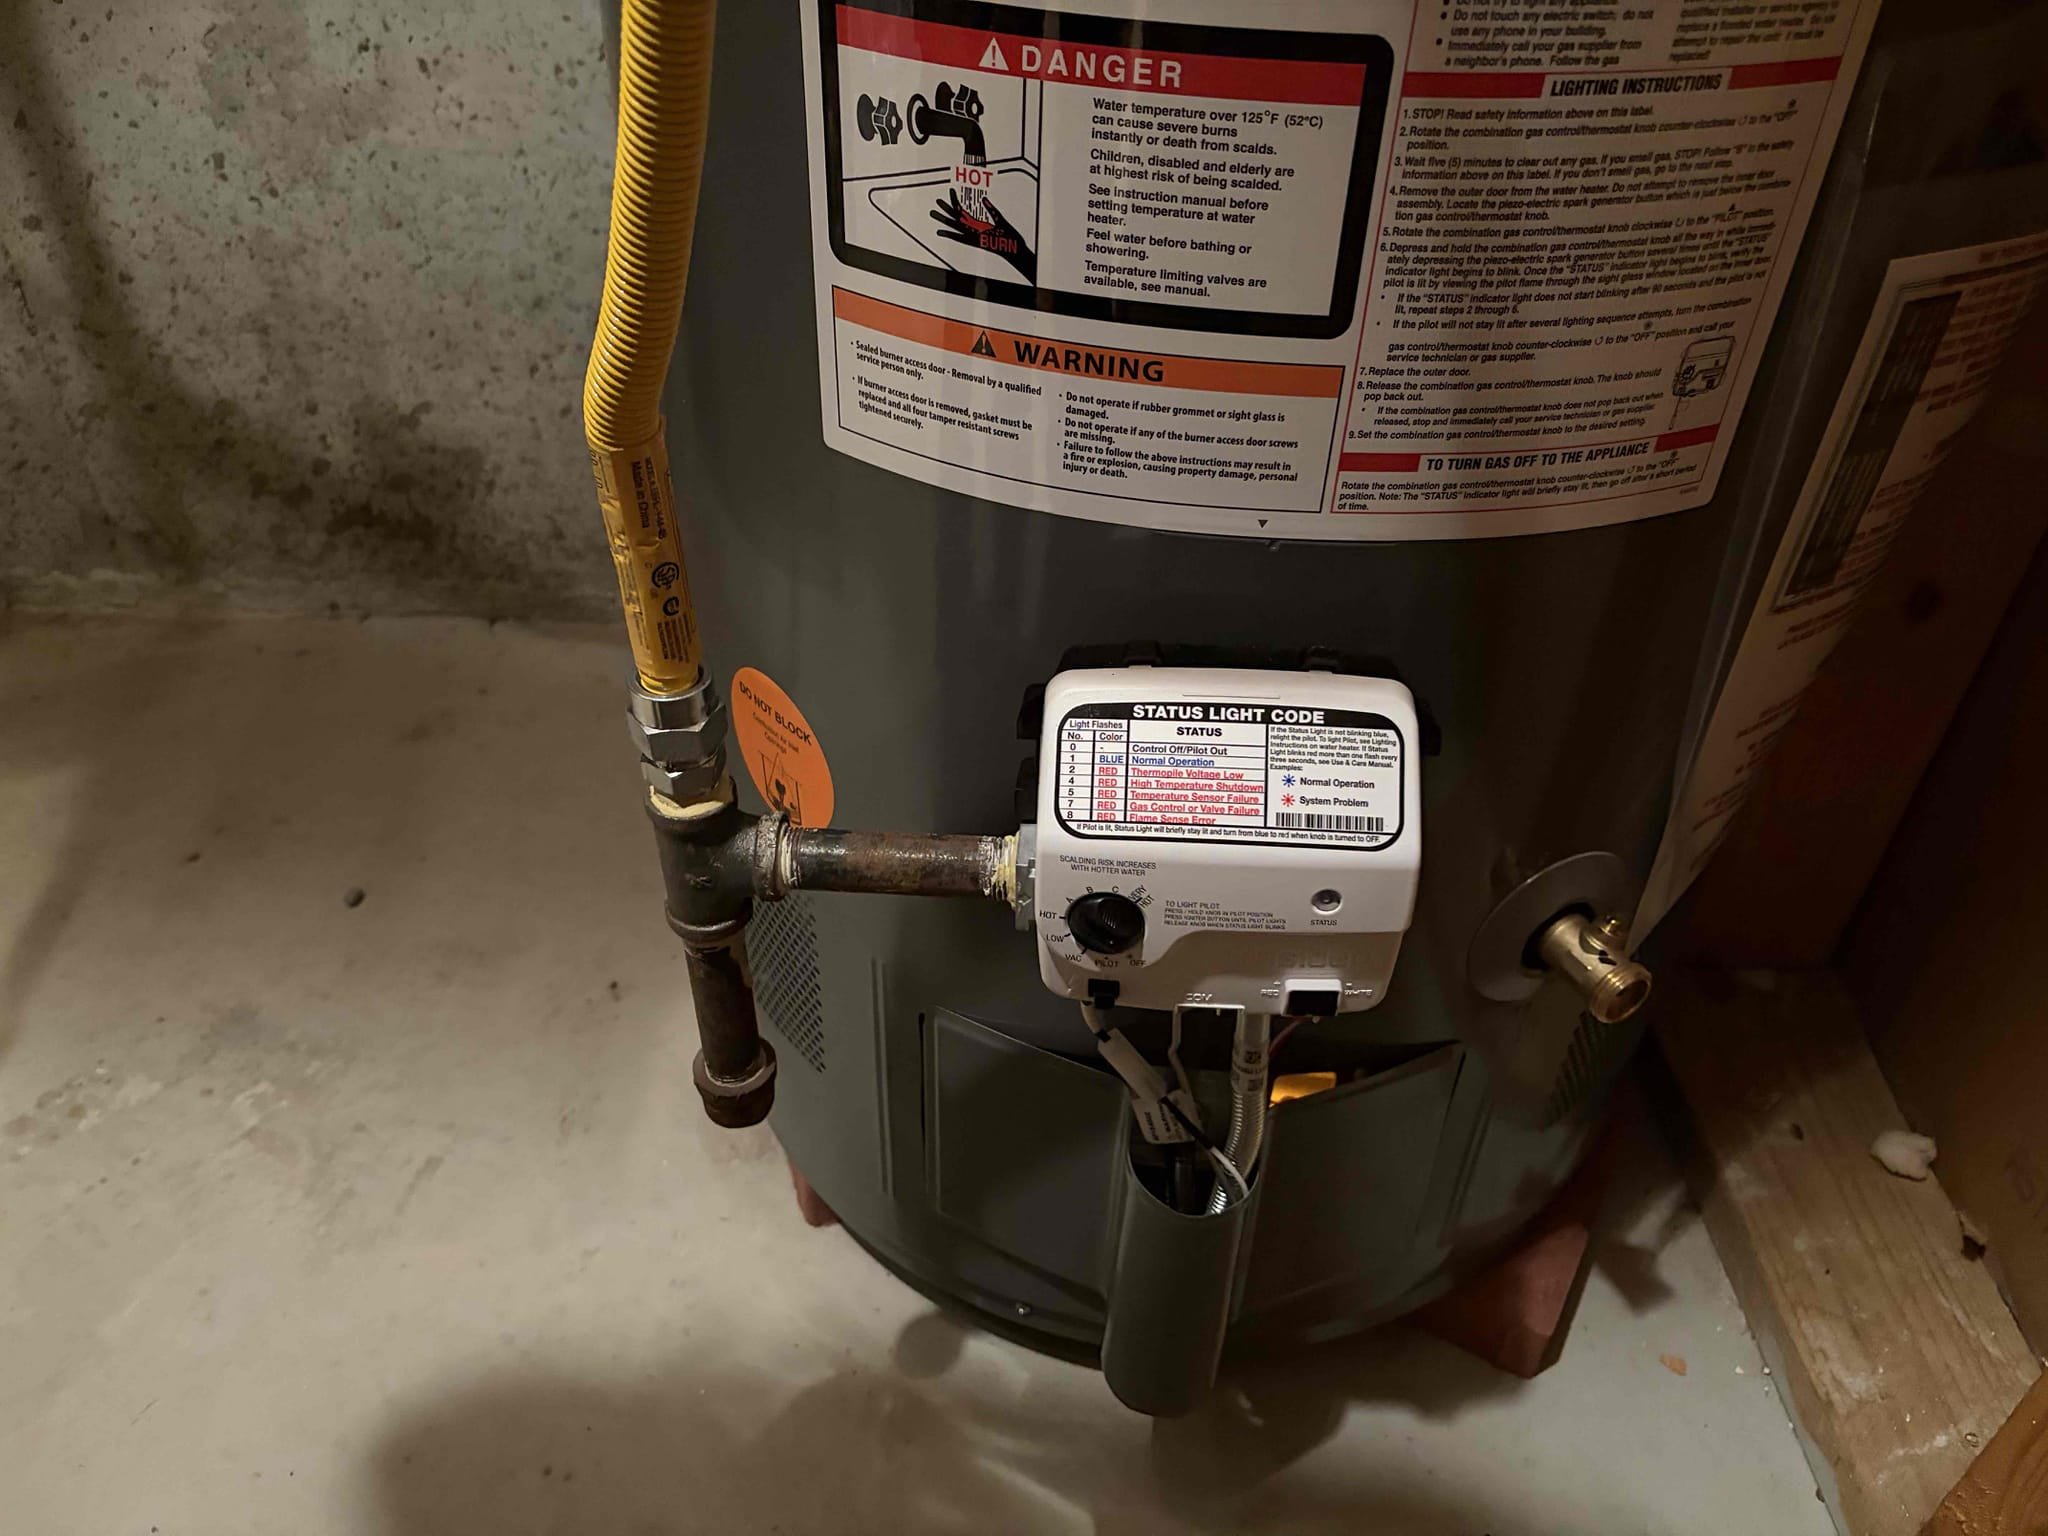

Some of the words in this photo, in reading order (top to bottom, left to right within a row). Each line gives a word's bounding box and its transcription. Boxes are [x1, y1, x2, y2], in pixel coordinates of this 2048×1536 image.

[1021, 46, 1181, 88] DANGER
[1549, 79, 1619, 97] LIGHTING
[1621, 74, 1723, 94] INSTRUCTIONS
[1093, 97, 1128, 112] Water
[1131, 103, 1207, 120] temperature
[1209, 111, 1238, 123] over
[1091, 115, 1114, 126] can
[1116, 118, 1154, 130] cause
[1156, 122, 1198, 135] severe
[1201, 124, 1238, 138] burns
[1091, 128, 1144, 147] instantly
[1146, 136, 1160, 146] or
[1162, 137, 1197, 149] death
[1200, 139, 1230, 152] from
[1232, 143, 1277, 155] scalds.
[1090, 148, 1145, 167] Children,
[1147, 155, 1200, 171] disabled
[1202, 162, 1227, 173] and
[1229, 163, 1272, 179] elderly
[1274, 167, 1295, 178] are
[955, 166, 993, 188] HOT
[1089, 164, 1101, 175] at
[1103, 165, 1149, 180] highest
[1151, 170, 1175, 183] risk
[1177, 173, 1191, 185] of
[1193, 174, 1228, 190] being
[1230, 179, 1282, 191] scalded.
[1088, 183, 1111, 197] See
[1113, 187, 1178, 204] instruction
[1181, 196, 1227, 208] manual
[1229, 198, 1269, 211] before
[1087, 199, 1128, 215] setting
[1131, 204, 1204, 220] temperature
[1206, 211, 1219, 222] at
[1221, 213, 1256, 224] water
[1087, 212, 1127, 227] heater.
[979, 234, 1017, 254] BURN
[1086, 227, 1111, 241] Feel
[1113, 233, 1147, 245] water
[1149, 235, 1188, 249] before
[1190, 239, 1236, 256] bathing
[1238, 245, 1253, 255] or
[1085, 243, 1149, 261] showering.
[1084, 260, 1157, 279] Temperature
[1159, 269, 1204, 286] limiting
[1206, 274, 1245, 287] valves
[1247, 278, 1267, 289] are
[1083, 276, 1138, 291] available,
[1140, 282, 1162, 293] see
[1164, 285, 1211, 297] manual.
[856, 353, 880, 366] service
[881, 360, 905, 374] person
[905, 368, 924, 381] only.
[1013, 340, 1164, 382] WARNING
[855, 340, 879, 355] Sealed
[879, 348, 904, 363] burner
[904, 357, 928, 370] access
[927, 362, 946, 375] door
[951, 368, 986, 384] Removal
[986, 376, 997, 389] by
[997, 381, 1004, 389] a
[1004, 382, 1042, 396] qualified
[1368, 367, 1405, 378] Replace
[1406, 367, 1422, 377] the
[1423, 368, 1447, 377] outer
[1448, 368, 1471, 377] door.
[1427, 458, 1444, 471] TO
[1447, 458, 1482, 470] TURN
[1484, 456, 1511, 469] GAS
[1513, 455, 1538, 468] OFF
[1541, 453, 1558, 466] TO
[1561, 450, 1584, 464] THE
[1585, 442, 1650, 461] APPLIANCE
[739, 681, 752, 700] DO
[754, 695, 772, 716] NOT
[775, 711, 812, 746] BLOCK
[1132, 705, 1204, 719] STATUS
[1209, 707, 1265, 721] LIGHT
[1270, 709, 1325, 724] CODE
[1069, 720, 1089, 730] Light
[1092, 721, 1123, 729] Flashes
[1067, 732, 1083, 740] No.
[1099, 733, 1123, 741] Color
[1176, 727, 1223, 737] STATUS
[1069, 742, 1077, 751] 0
[1132, 744, 1167, 754] Control
[1168, 745, 1208, 756] Off/Pilot
[1209, 746, 1228, 756] Out
[1070, 754, 1075, 762] 1
[1099, 755, 1124, 763] BLUE
[1132, 756, 1165, 765] Normal
[1168, 758, 1215, 767] Operation
[1068, 766, 1076, 774] 2
[1099, 767, 1118, 775] RED
[1131, 768, 1184, 779] Thermopile
[1186, 770, 1221, 779] Voltage
[1223, 772, 1244, 780] Low
[1068, 777, 1075, 785] 4
[1098, 778, 1117, 787] RED
[1131, 780, 1152, 789] High
[1155, 780, 1213, 790] Temperature
[1216, 782, 1264, 792] Shutdown
[1299, 777, 1332, 787] Normal
[1332, 779, 1375, 789] Operation
[1067, 788, 1075, 796] 5
[1098, 790, 1117, 798] RED
[1130, 791, 1189, 801] Temperature
[1191, 793, 1225, 802] Sensor
[1227, 795, 1259, 804] Failure
[1067, 799, 1074, 808] 7
[1097, 801, 1117, 809] RED
[1299, 796, 1332, 806] System
[1333, 797, 1369, 807] Problem
[1130, 803, 1149, 812] Gas
[1151, 803, 1185, 813] Control
[1200, 805, 1226, 814] Valve
[1228, 806, 1260, 815] Failure
[1066, 811, 1074, 820] 8
[1097, 813, 1116, 821] RED
[1130, 814, 1159, 823] Flame
[1161, 815, 1189, 824] Sense
[1192, 816, 1216, 825] Error
[1059, 855, 1097, 865] SCALDING
[1097, 858, 1115, 867] RISK
[1116, 860, 1157, 870] INCREASES
[1070, 864, 1090, 872] WITH
[1090, 866, 1120, 874] HOTTER
[1120, 868, 1146, 876] WATER
[1128, 885, 1147, 901] VERY
[1139, 895, 1155, 908] HOT
[1165, 900, 1176, 909] TO
[1199, 902, 1220, 910] PILOT
[1039, 910, 1057, 920] HOT
[1046, 934, 1065, 943] LOW
